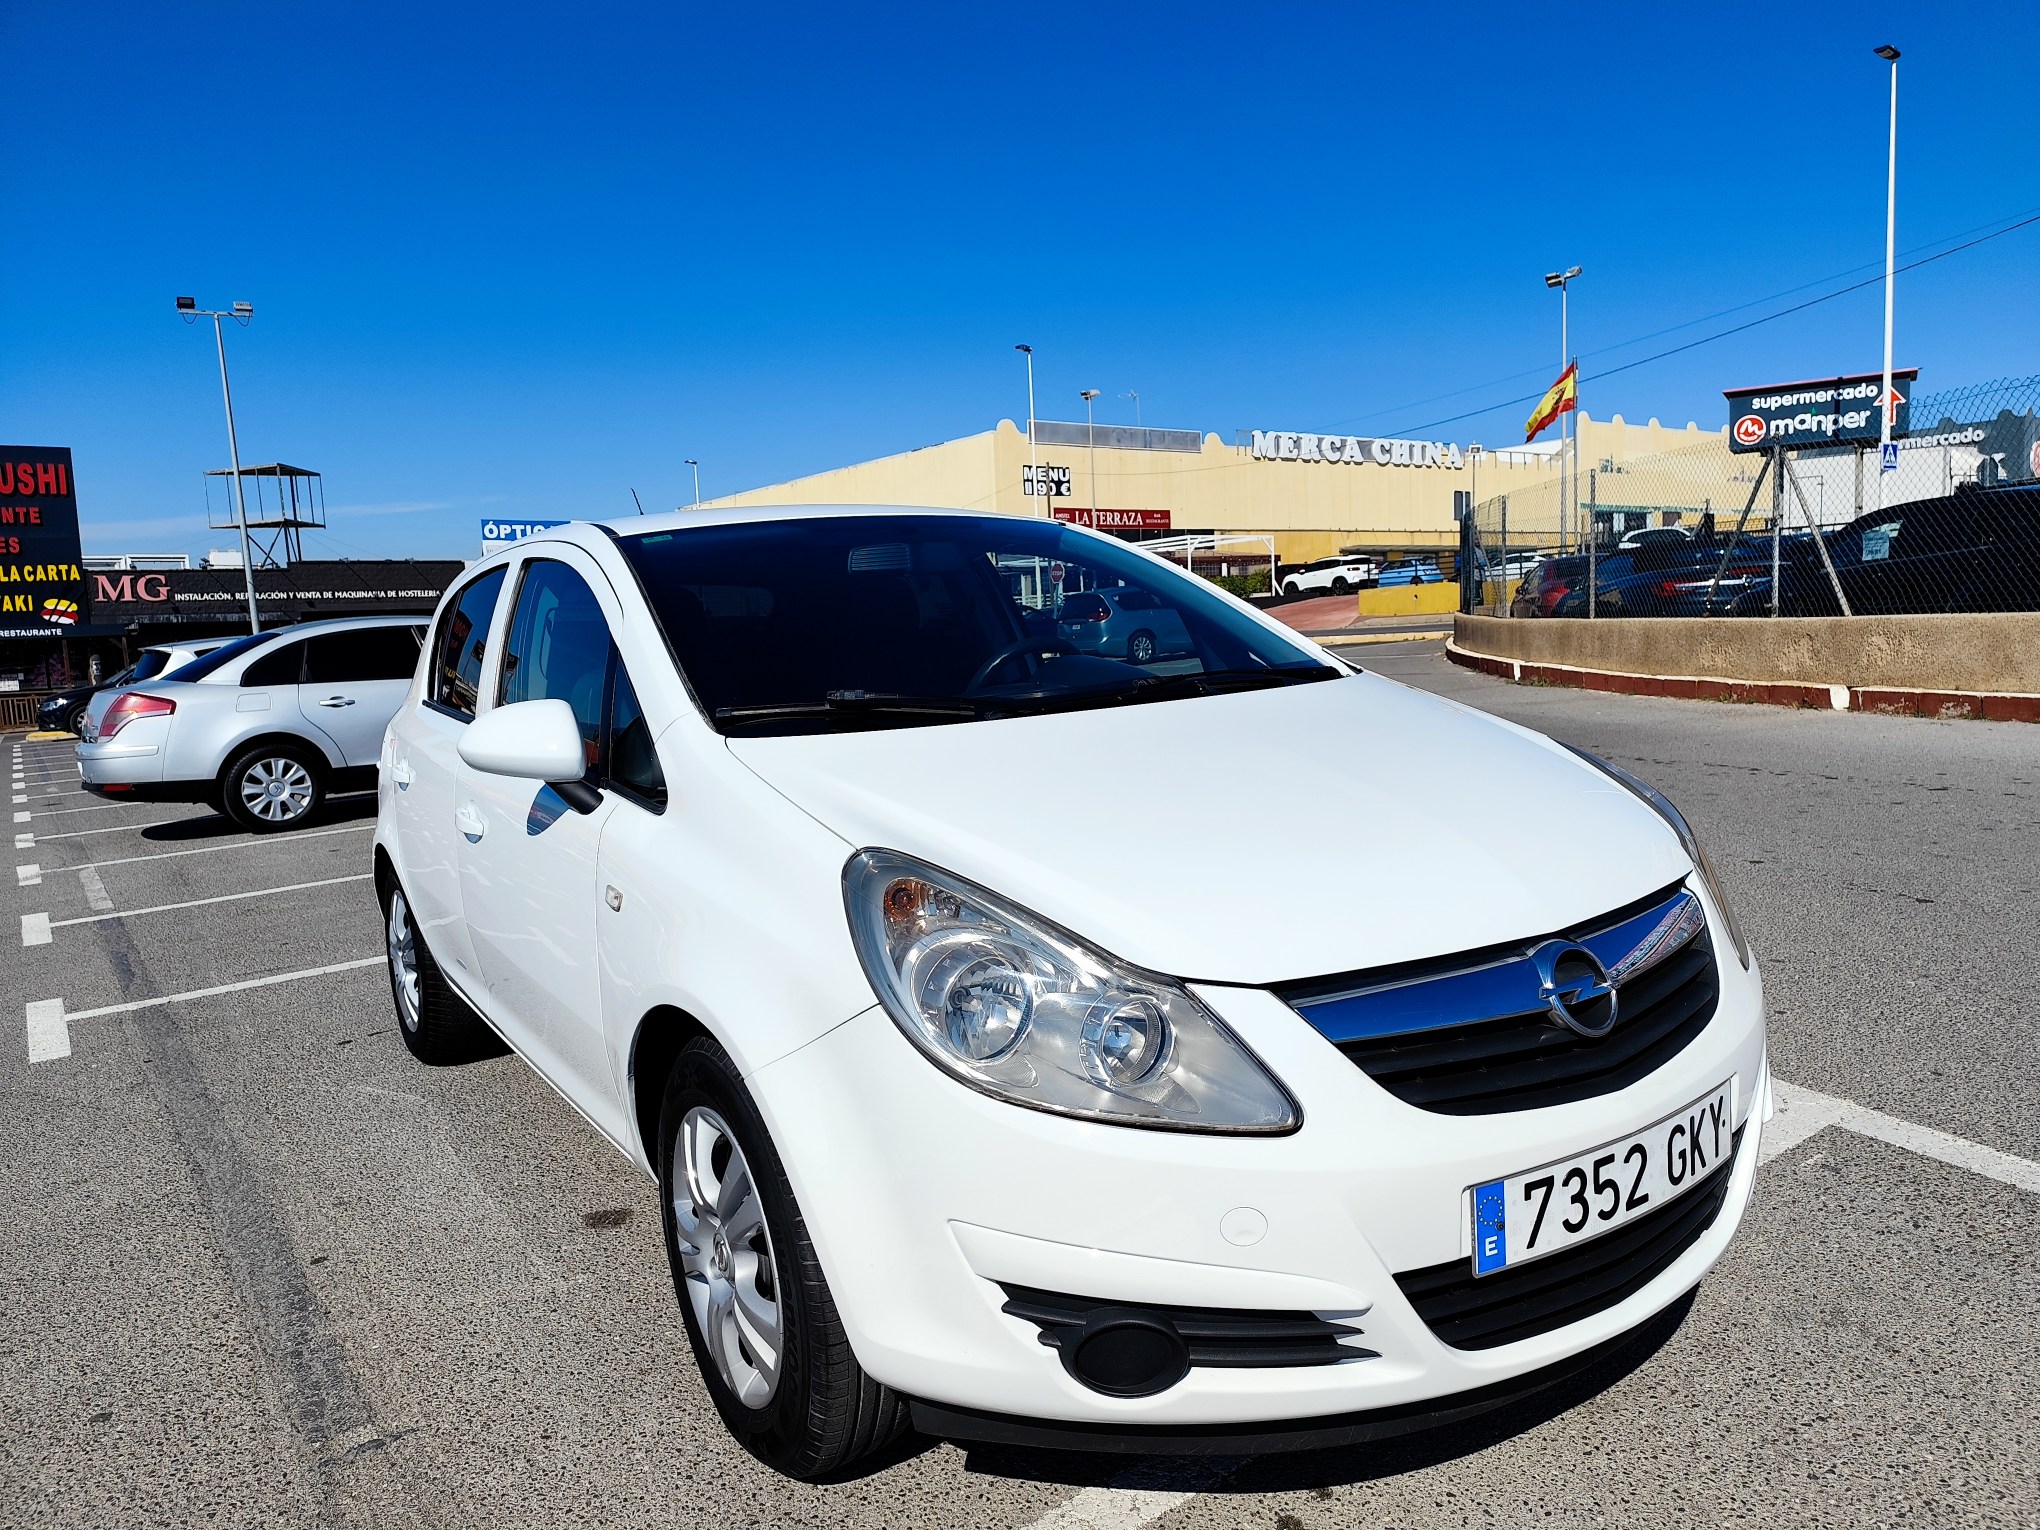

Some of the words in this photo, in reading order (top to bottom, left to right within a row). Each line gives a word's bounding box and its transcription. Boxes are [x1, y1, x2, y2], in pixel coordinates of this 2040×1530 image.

[1751, 382, 1879, 412] supermercado
[1769, 409, 1872, 437] manper
[1251, 429, 1364, 466] MERCA
[1371, 438, 1465, 470] CHINA
[0, 462, 68, 495] USHI
[1023, 466, 1070, 481] MENÚ
[1, 506, 41, 524] NTE
[1074, 510, 1090, 525] LA
[1091, 511, 1144, 526] TERRAZA
[0, 536, 20, 554] ES
[0, 565, 21, 582] LA
[23, 564, 81, 582] CARTA
[93, 574, 171, 602] MG
[174, 590, 234, 601] INSTALACIÓN,
[235, 590, 288, 600] REPRACIÓN
[288, 591, 295, 599] Y
[295, 591, 322, 600] VENTA
[323, 591, 334, 599] DE
[387, 590, 398, 598] DE
[0, 594, 34, 612] AKI
[0, 628, 63, 637] RESTAURANTE
[1523, 1142, 1650, 1250] 7352
[1667, 1094, 1725, 1187] GKY
[1484, 1235, 1499, 1258] E
